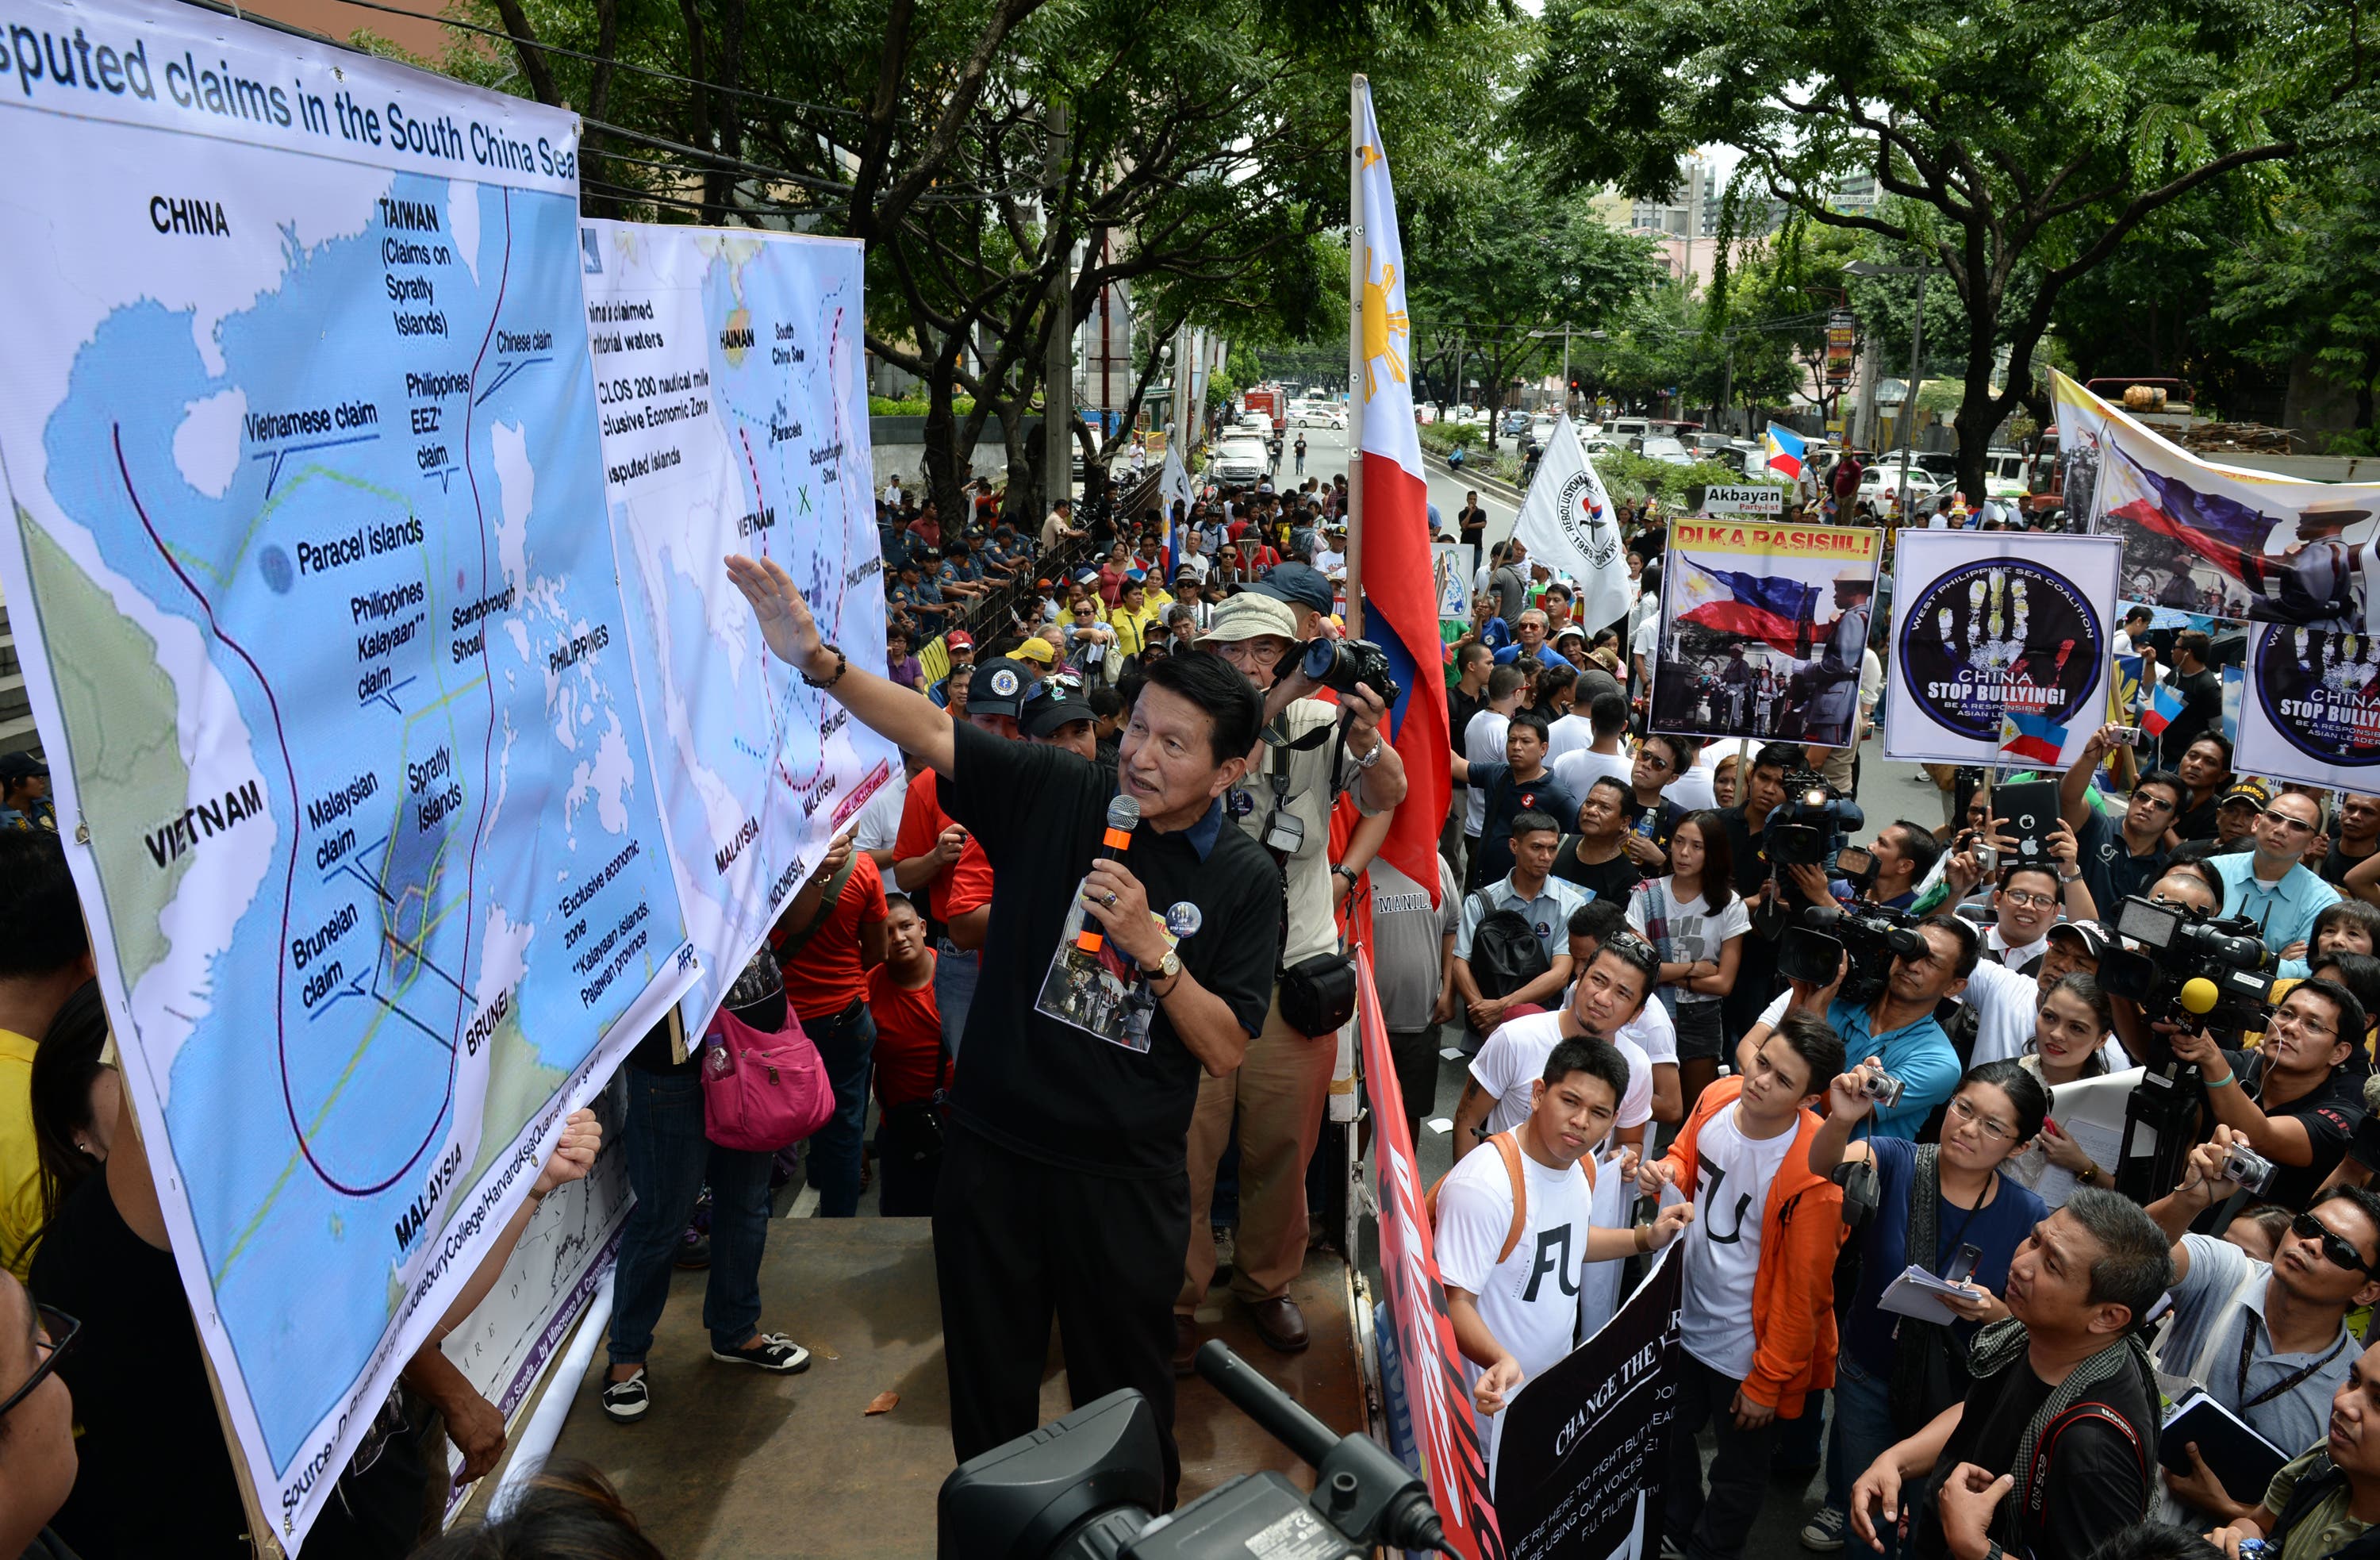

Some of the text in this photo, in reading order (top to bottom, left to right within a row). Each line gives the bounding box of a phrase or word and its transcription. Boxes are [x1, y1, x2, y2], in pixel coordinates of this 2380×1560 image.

[165, 50, 292, 128] claims
[295, 78, 329, 135] in
[335, 90, 382, 146] the
[387, 102, 465, 161] South
[470, 121, 536, 174] China
[538, 136, 575, 180] Sea
[149, 194, 231, 238] CHINA
[379, 198, 440, 232] TAIWAN
[382, 237, 451, 268] (Claims on
[386, 274, 433, 305] Spratly
[393, 310, 447, 339] Islands)
[614, 299, 654, 323] claimed
[497, 330, 553, 353] Chinese claim
[624, 330, 664, 350] waters
[720, 329, 754, 350] HAINAN
[775, 322, 793, 340] South
[772, 346, 804, 366] China Sea
[405, 372, 470, 402] Philippines
[635, 376, 656, 398] 200
[659, 371, 692, 394] nautical
[693, 368, 708, 390] mile
[244, 400, 378, 442] Vietnamese claim
[645, 400, 689, 428] Economic
[690, 397, 708, 417] Zone
[771, 420, 802, 443] Paracels
[417, 444, 449, 470] claim
[1708, 488, 1780, 504] Akbayan
[737, 507, 775, 540] VIETNAM
[1678, 525, 1703, 544] DI
[1708, 528, 1746, 547] KA
[297, 517, 424, 575] Paracel islands
[846, 555, 881, 591] PHILIPPINES
[351, 580, 424, 625] Philippines
[451, 582, 516, 632] Scarborough
[1911, 567, 2094, 640] WEST PHILIPPINE SEA COALITION
[452, 630, 484, 664] Shoal
[549, 624, 609, 677] PHILIPPINES
[358, 664, 391, 700] claim
[1928, 682, 2066, 705] STOP BULLYING!
[1958, 670, 2033, 685] CHINA
[1971, 703, 2045, 713] RESPONSIBLE
[2280, 698, 2324, 720] STOP
[2310, 689, 2380, 709] CHINA
[820, 707, 847, 741] BRUNEI
[2307, 729, 2337, 739] ASIAN
[408, 744, 450, 794] Spratly
[307, 771, 378, 832] Malaysian
[418, 782, 462, 833] Islands
[802, 774, 835, 820] MALAYSIA
[1524, 794, 1534, 805] 5
[144, 779, 263, 869] VIETNAM
[317, 828, 356, 870] claim
[605, 838, 640, 882] economic
[715, 816, 759, 876] MALAYSIA
[769, 855, 805, 913] INDONESIA
[292, 902, 359, 970] Bruneian
[564, 918, 586, 950] zone
[580, 930, 647, 1010] Palawan province
[678, 943, 694, 976] AFP
[302, 960, 344, 1009] claim
[466, 987, 509, 1057] BRUNEI
[394, 1143, 463, 1252] MALAYSIA
[538, 1341, 550, 1363] by
[547, 1299, 577, 1344] Vincenzo
[575, 1288, 585, 1302] M.
[1556, 1374, 1618, 1457] CHANGE
[1621, 1342, 1656, 1385] THE
[1548, 1490, 1575, 1527] HERE
[1576, 1476, 1591, 1495] TO
[1592, 1445, 1624, 1481] FIGHT
[1626, 1426, 1645, 1454] BUT
[2036, 1454, 2048, 1487] EOS
[1546, 1454, 1643, 1551] USING OUR VOICES
